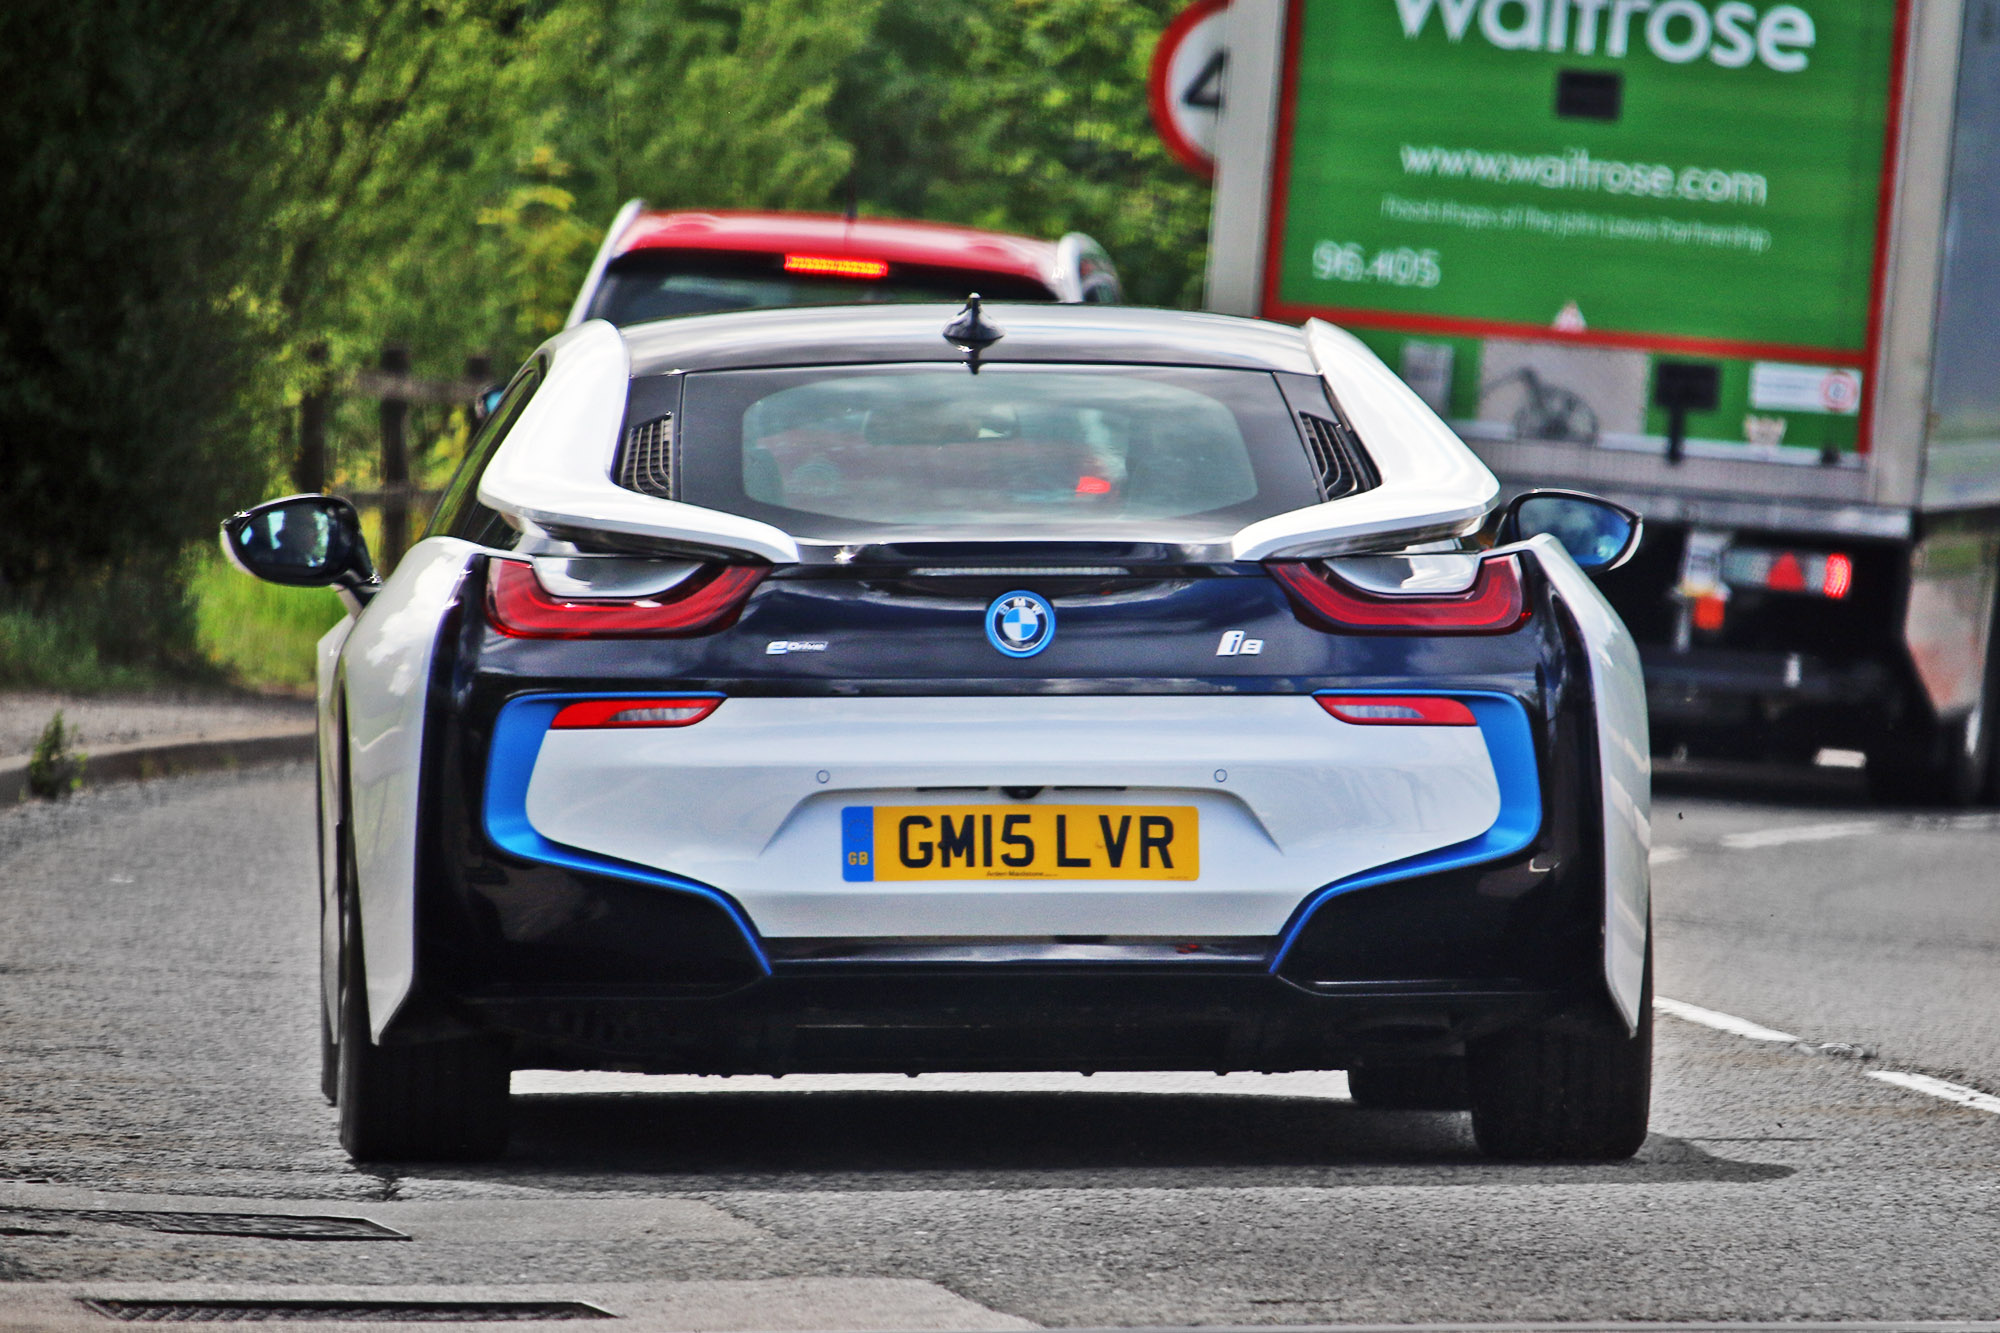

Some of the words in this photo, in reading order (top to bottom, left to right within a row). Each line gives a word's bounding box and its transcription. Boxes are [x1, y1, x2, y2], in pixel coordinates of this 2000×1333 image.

[1400, 144, 1768, 206] www.waitrose.com
[999, 597, 1045, 616] BMW
[1215, 630, 1264, 656] i8
[899, 813, 1035, 869] GM15
[1056, 813, 1175, 869] LVR
[848, 851, 869, 866] GB
